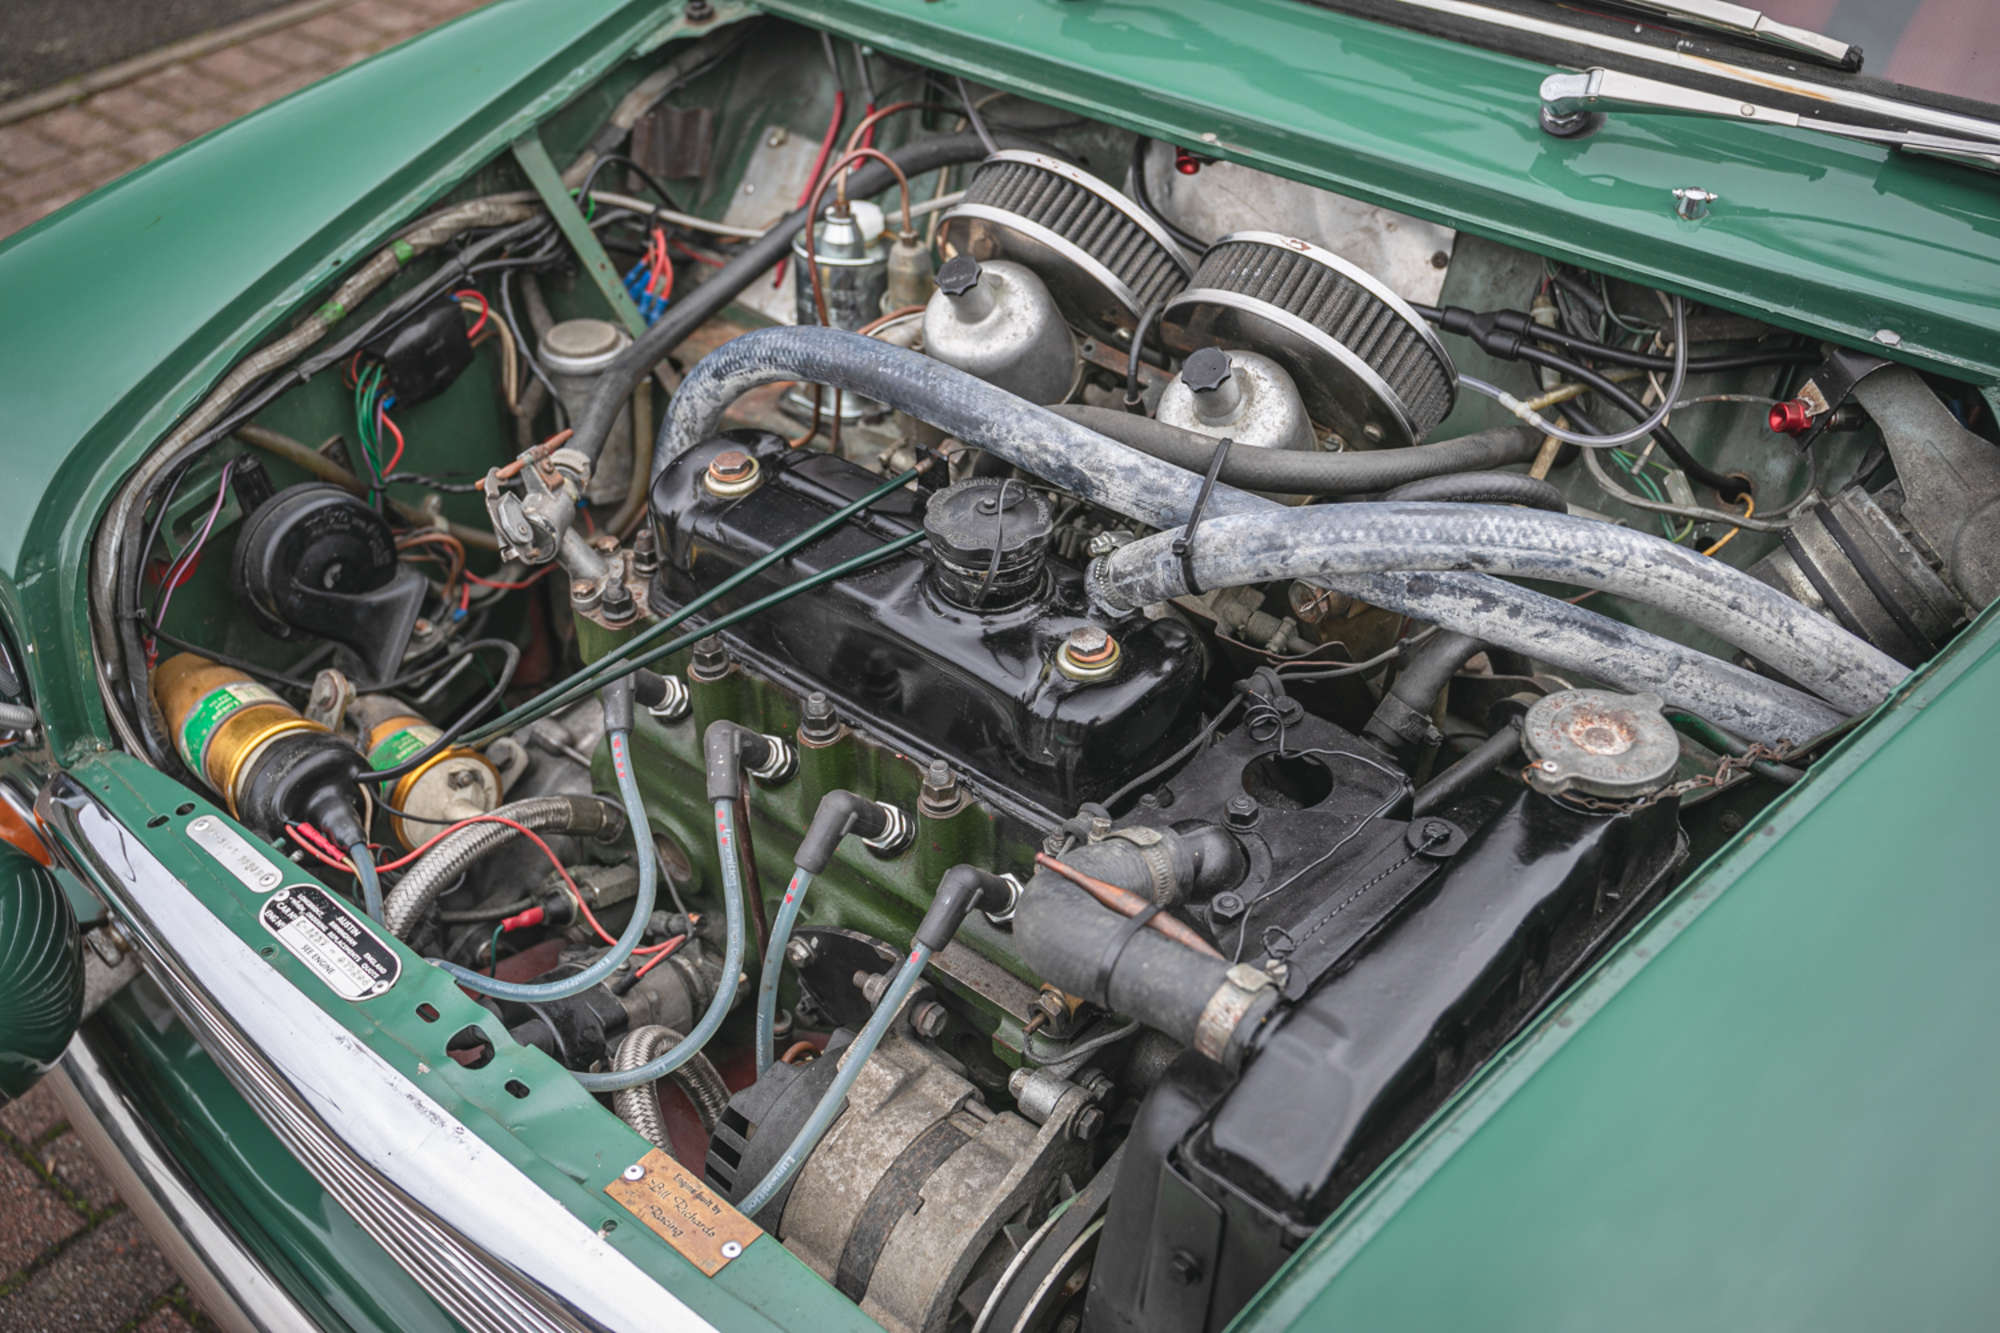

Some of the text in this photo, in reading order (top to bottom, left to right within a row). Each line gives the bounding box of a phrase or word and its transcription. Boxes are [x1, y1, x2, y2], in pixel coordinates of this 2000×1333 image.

[276, 901, 291, 915] CAR
[336, 915, 361, 937] AUSTIN
[264, 909, 280, 923] ENG
[301, 944, 315, 957] SEE
[311, 953, 336, 976] ENGINE
[360, 962, 380, 979] QUOTE
[362, 952, 388, 974] ENGLAND
[648, 1178, 717, 1238] Bill Richards
[672, 1172, 697, 1195] Engine
[711, 1204, 722, 1216] by
[649, 1204, 684, 1238] Racing
